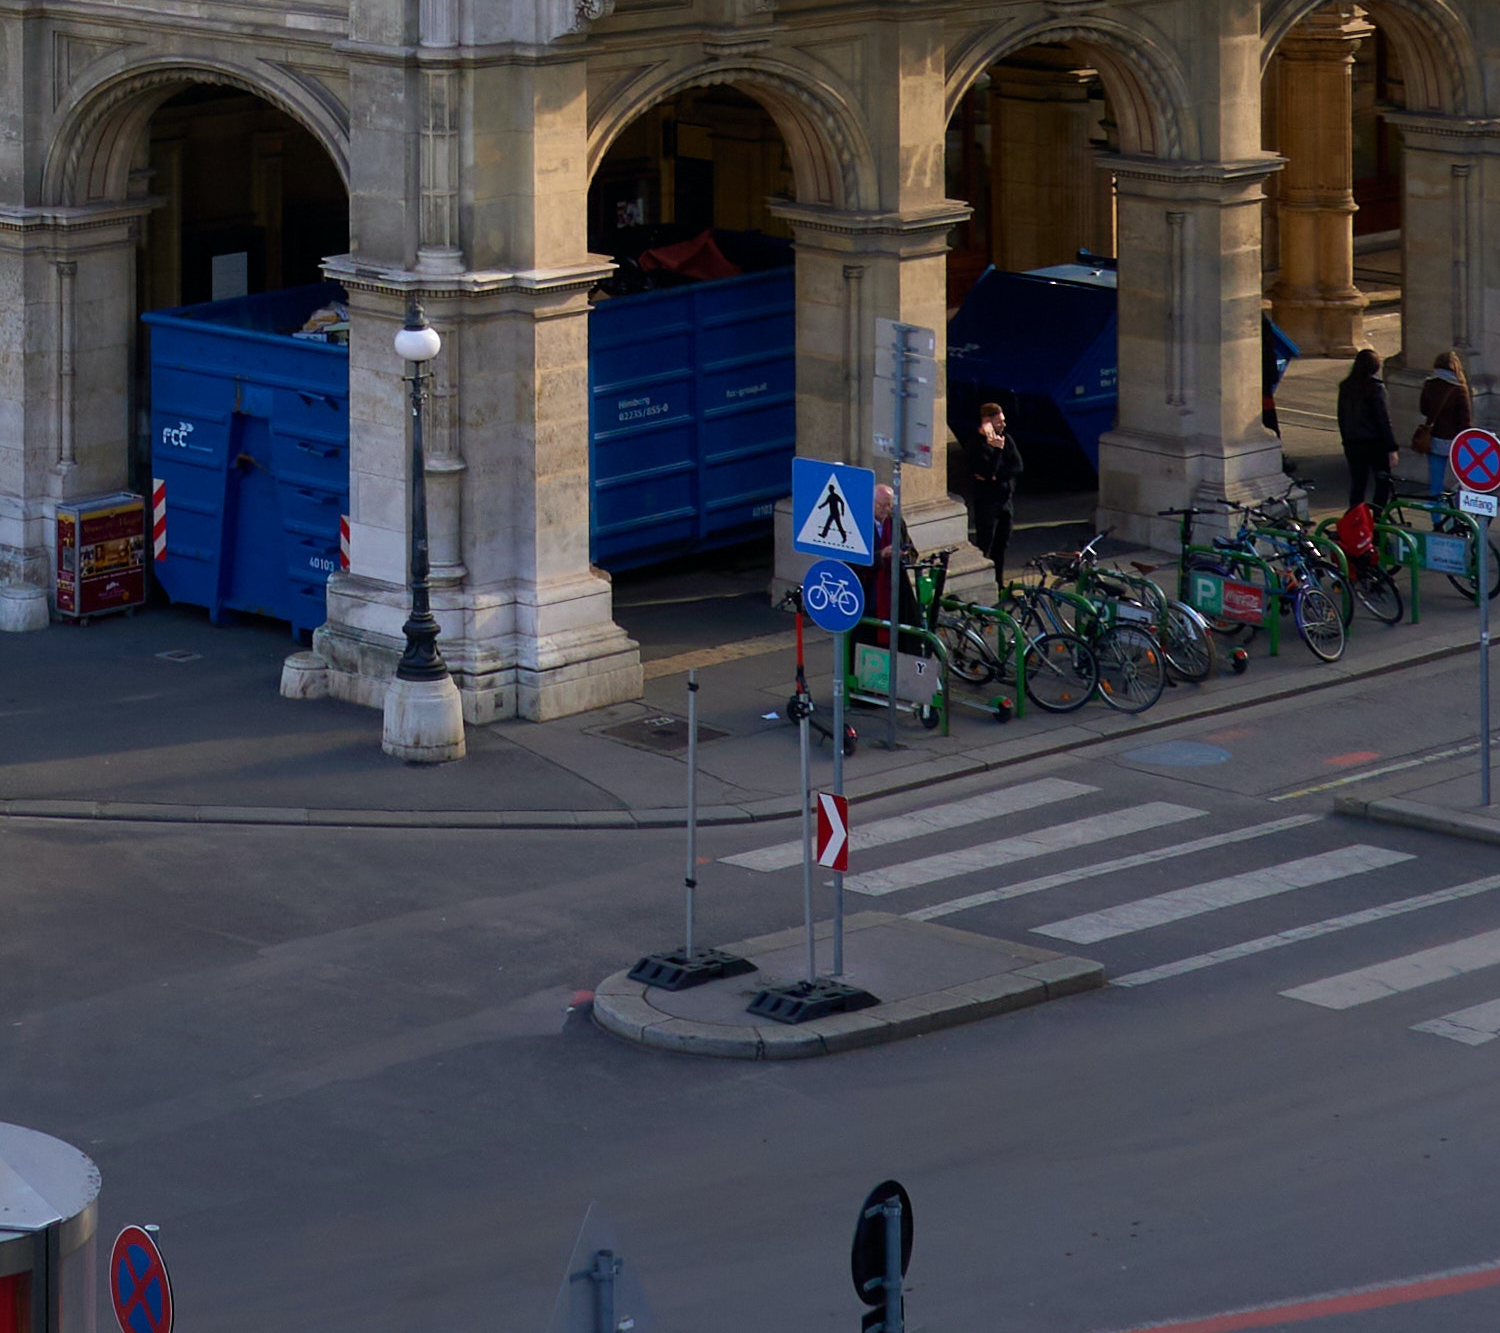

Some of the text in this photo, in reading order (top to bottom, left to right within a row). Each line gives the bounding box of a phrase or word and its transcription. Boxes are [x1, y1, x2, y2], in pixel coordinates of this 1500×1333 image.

[618, 397, 650, 410] Himberg
[163, 427, 188, 448] FCC
[1196, 578, 1217, 607] P
